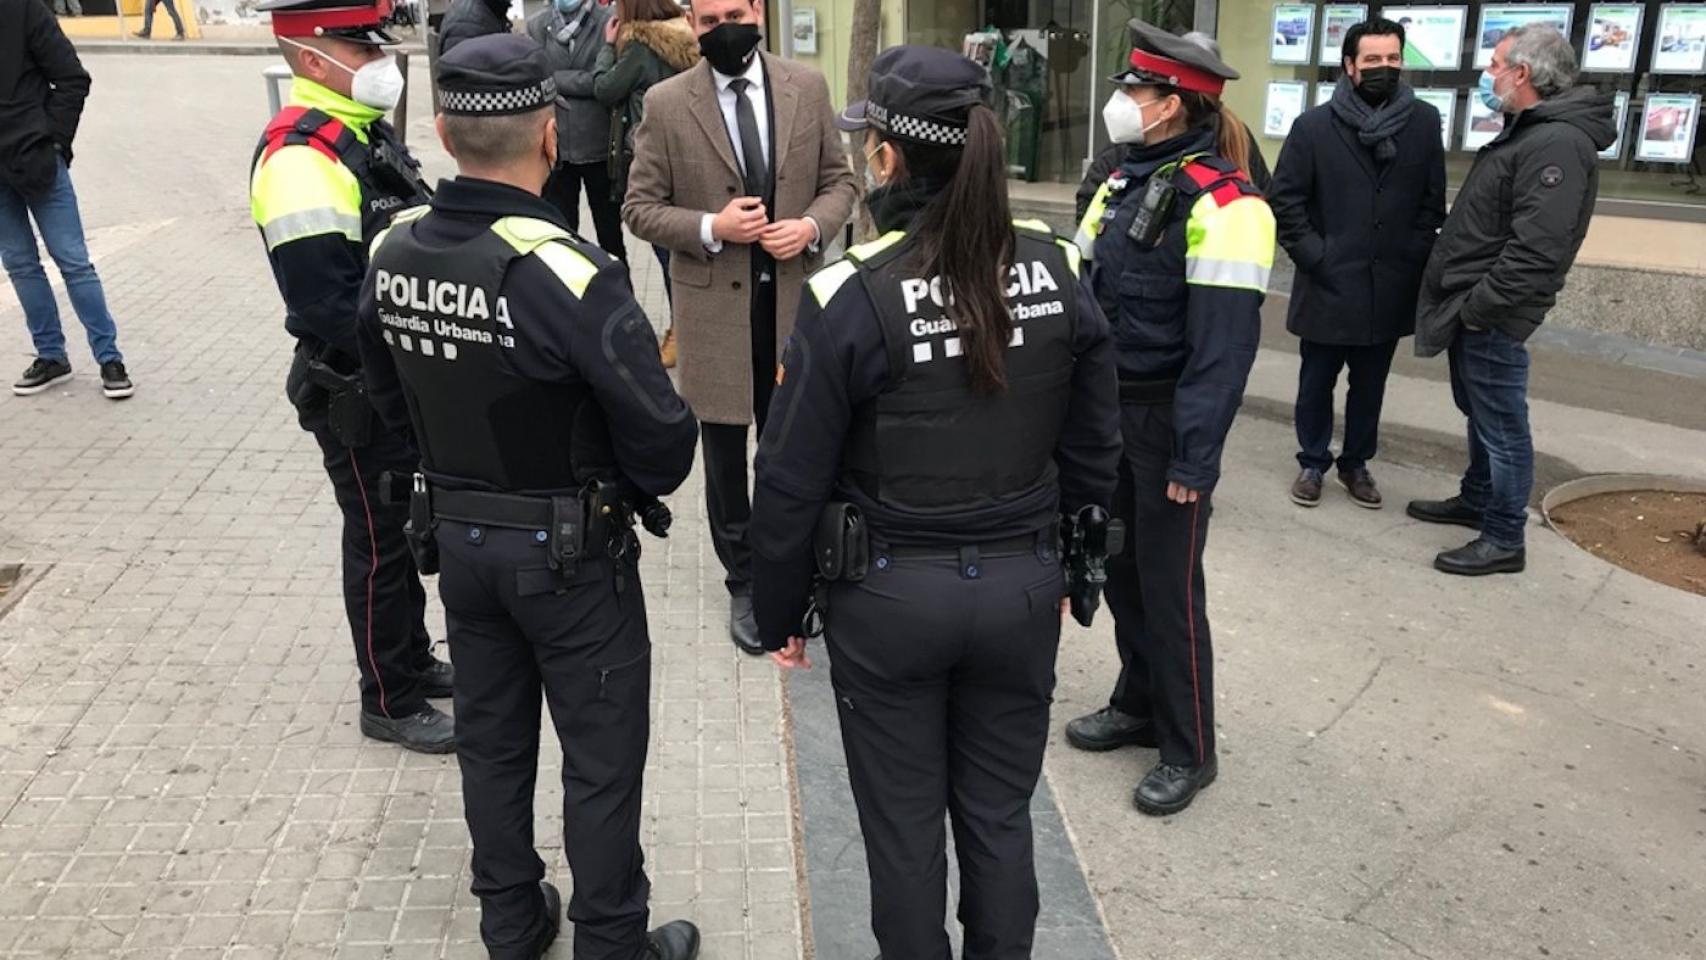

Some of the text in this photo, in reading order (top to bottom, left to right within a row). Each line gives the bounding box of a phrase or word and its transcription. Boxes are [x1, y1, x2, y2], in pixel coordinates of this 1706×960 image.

[375, 269, 489, 320] POLICIA
[901, 261, 1058, 313] POCIA
[377, 307, 492, 344] Guàrdia Urbana
